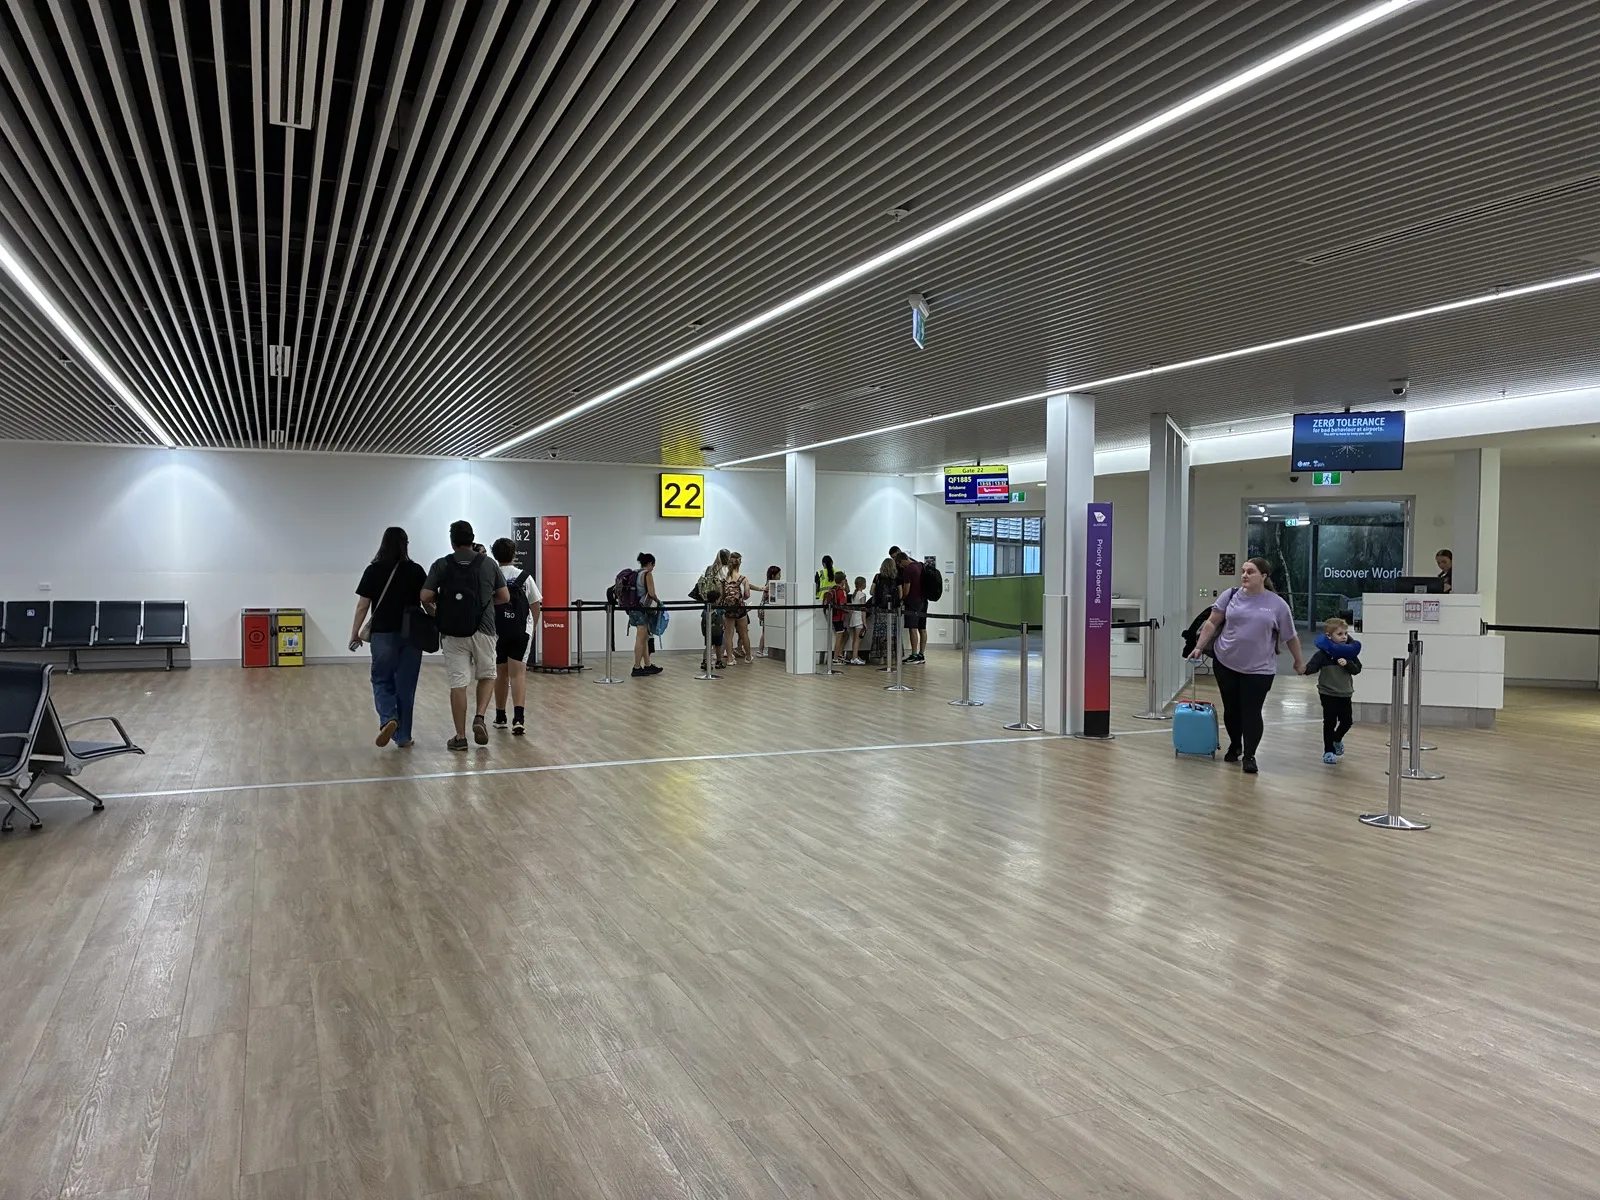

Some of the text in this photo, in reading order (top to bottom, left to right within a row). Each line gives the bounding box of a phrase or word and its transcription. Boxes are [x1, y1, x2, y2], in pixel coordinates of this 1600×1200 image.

[1312, 417, 1386, 428] ZERØ TOLERANCE
[664, 482, 702, 509] 22
[523, 529, 530, 541] 2
[1094, 538, 1103, 604] Priority Boarding
[1323, 566, 1370, 579] Discover
